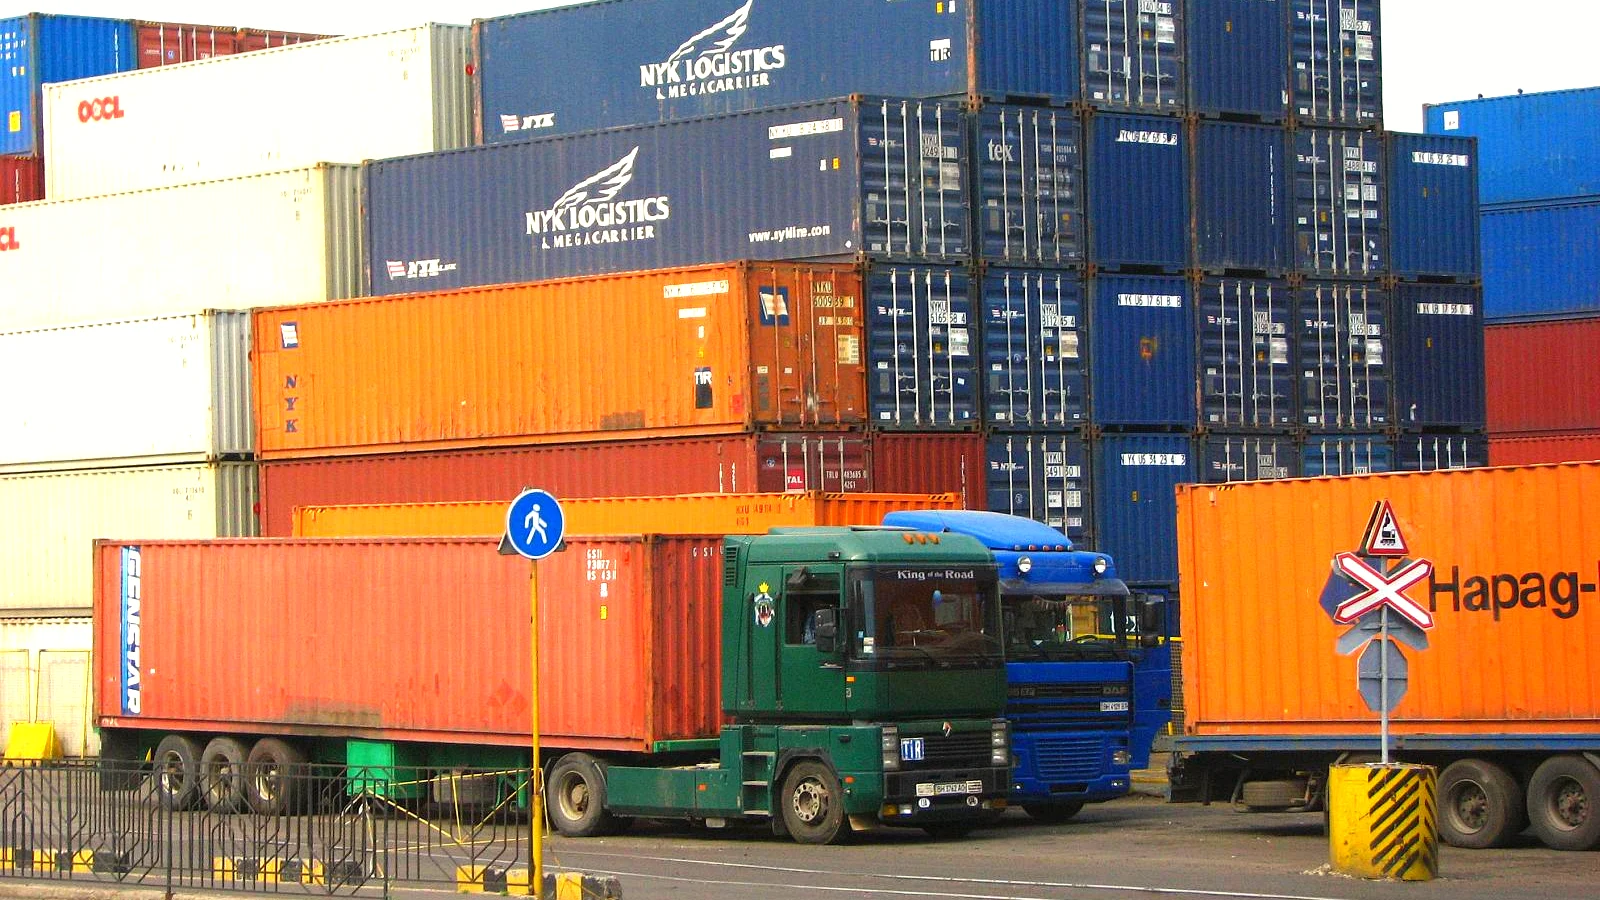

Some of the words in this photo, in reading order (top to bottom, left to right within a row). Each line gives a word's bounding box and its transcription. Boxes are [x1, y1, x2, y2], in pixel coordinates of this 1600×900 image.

[930, 48, 951, 61] TIR
[640, 61, 681, 86] NYK
[685, 45, 785, 82] LOGISTICS
[78, 96, 125, 123] OOCL
[521, 113, 555, 130] NYK
[526, 207, 566, 235] NYK
[569, 196, 671, 230] LOGISTICS
[694, 371, 712, 385] TIR
[787, 476, 803, 484] TAL
[897, 570, 926, 580] King
[944, 570, 974, 579] Road
[1428, 560, 1600, 622] Hapag-
[902, 740, 923, 760] TIR
